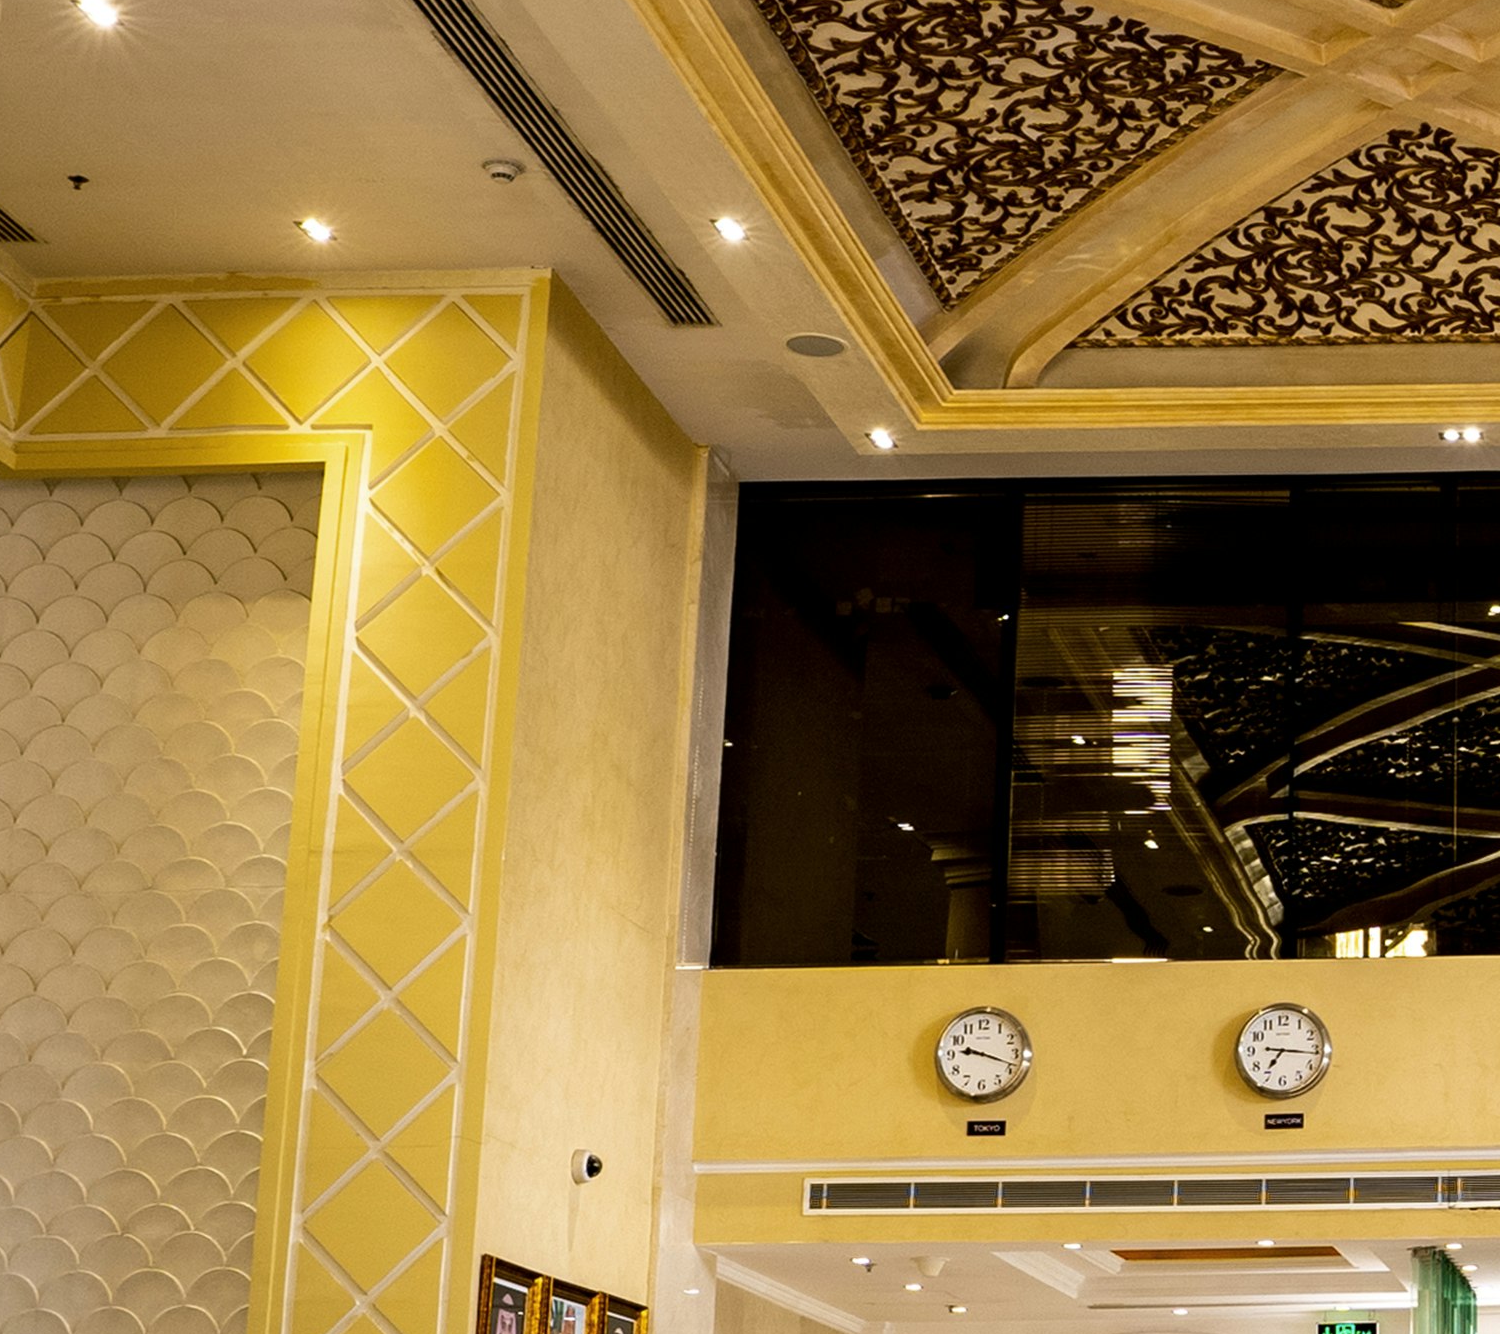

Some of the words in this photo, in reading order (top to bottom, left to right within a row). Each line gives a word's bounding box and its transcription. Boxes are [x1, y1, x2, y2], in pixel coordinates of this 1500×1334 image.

[979, 1019, 990, 1030] 12
[1264, 1020, 1273, 1031] 11
[1278, 1015, 1290, 1026] 12
[1298, 1019, 1302, 1030] 1
[964, 1023, 973, 1035] 11
[998, 1023, 1002, 1034] 1
[953, 1035, 965, 1046] 10
[1007, 1034, 1015, 1045] 2
[1253, 1031, 1264, 1042] 10
[1306, 1030, 1315, 1041] 2
[947, 1050, 955, 1061] 9
[1012, 1049, 1019, 1059] 3
[1247, 1047, 1256, 1057] 9
[952, 1065, 960, 1075] 8
[1253, 1061, 1260, 1072] 8
[1306, 1060, 1312, 1071] 4
[963, 1075, 971, 1086] 7
[994, 1075, 1002, 1085] 5
[1264, 1071, 1271, 1082] 7
[1279, 1075, 1287, 1087] 6
[1295, 1071, 1303, 1081] 5
[978, 1080, 986, 1091] 6
[973, 1124, 1001, 1132] TOKYO
